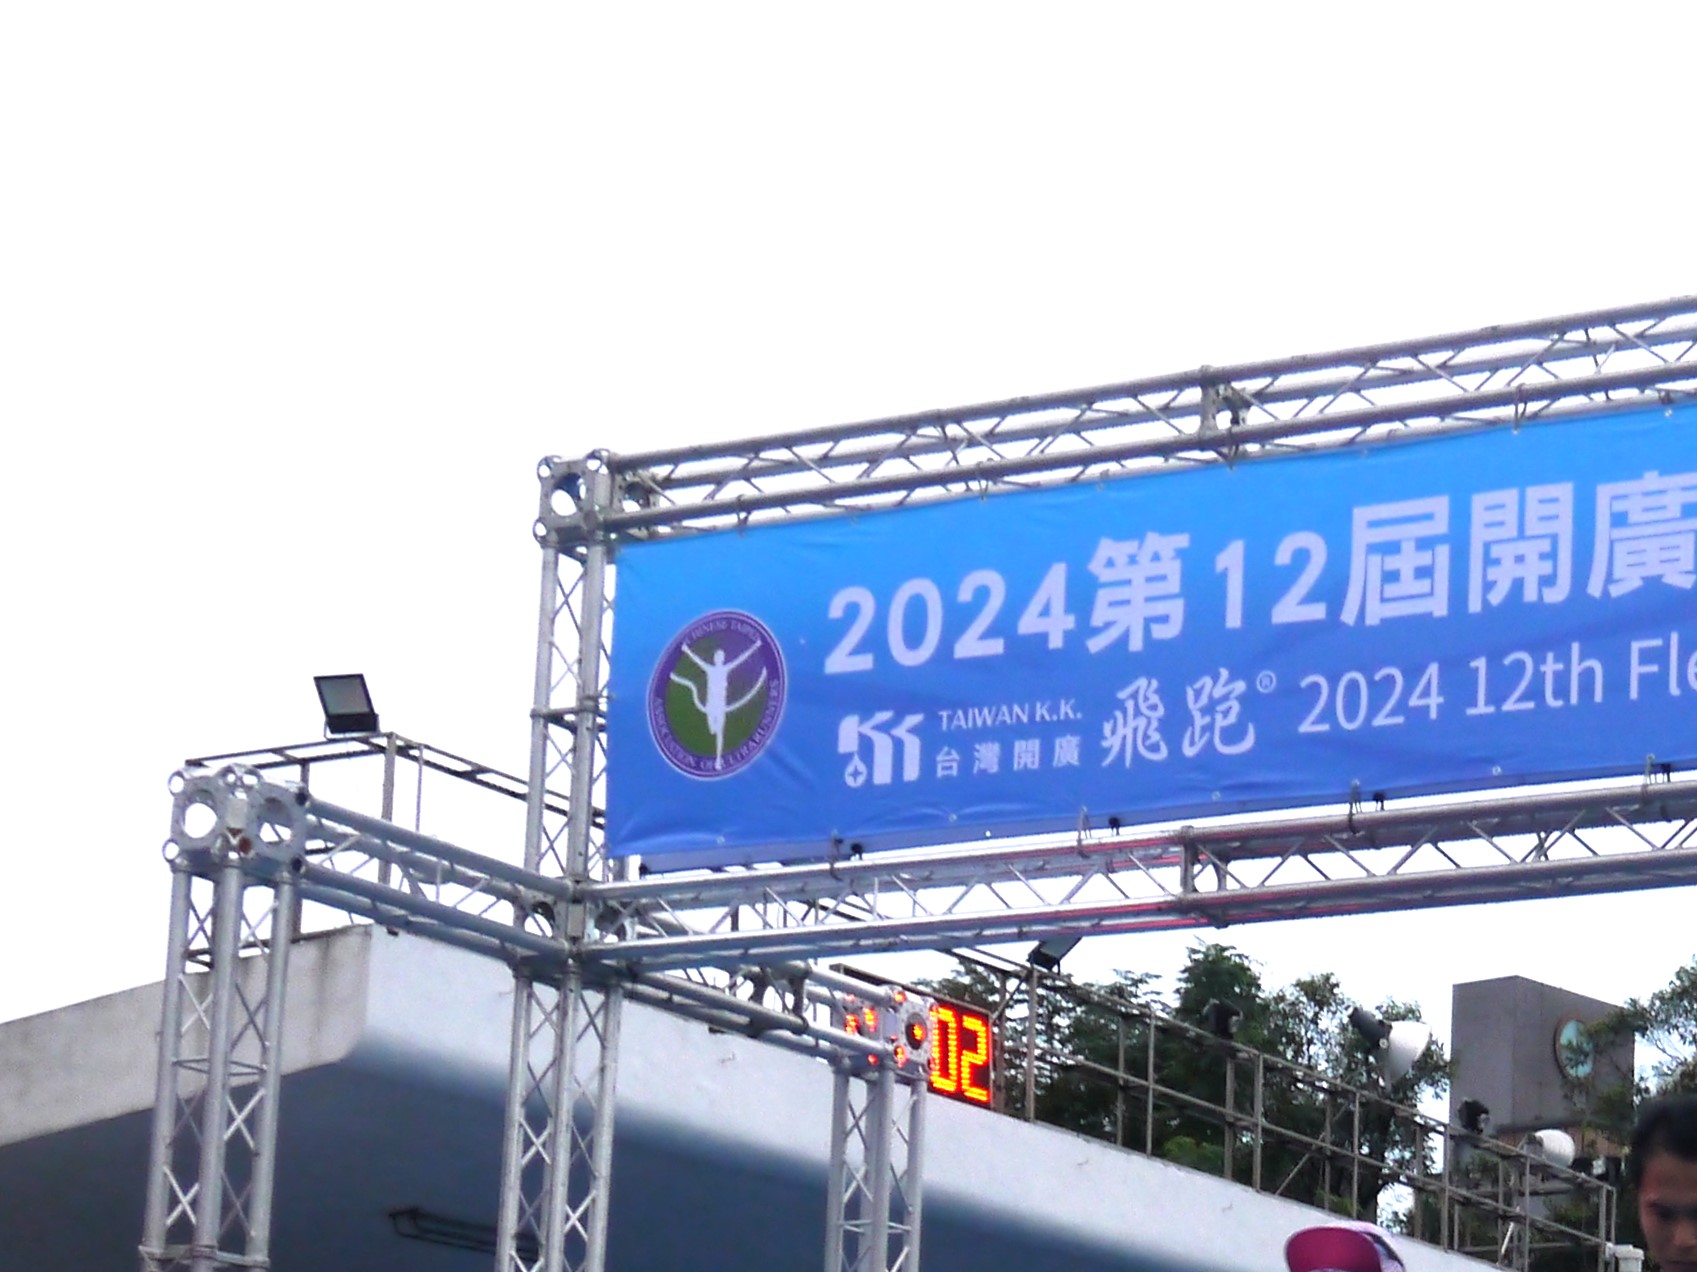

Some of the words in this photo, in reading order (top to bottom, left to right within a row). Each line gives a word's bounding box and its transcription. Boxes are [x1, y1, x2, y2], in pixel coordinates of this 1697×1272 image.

[1298, 671, 1445, 735] 2024
[1465, 641, 1603, 717] 12th
[938, 703, 1028, 732] TAIWAN
[1036, 698, 1083, 723] K.K.
[935, 735, 1081, 778] 台灣開廣
